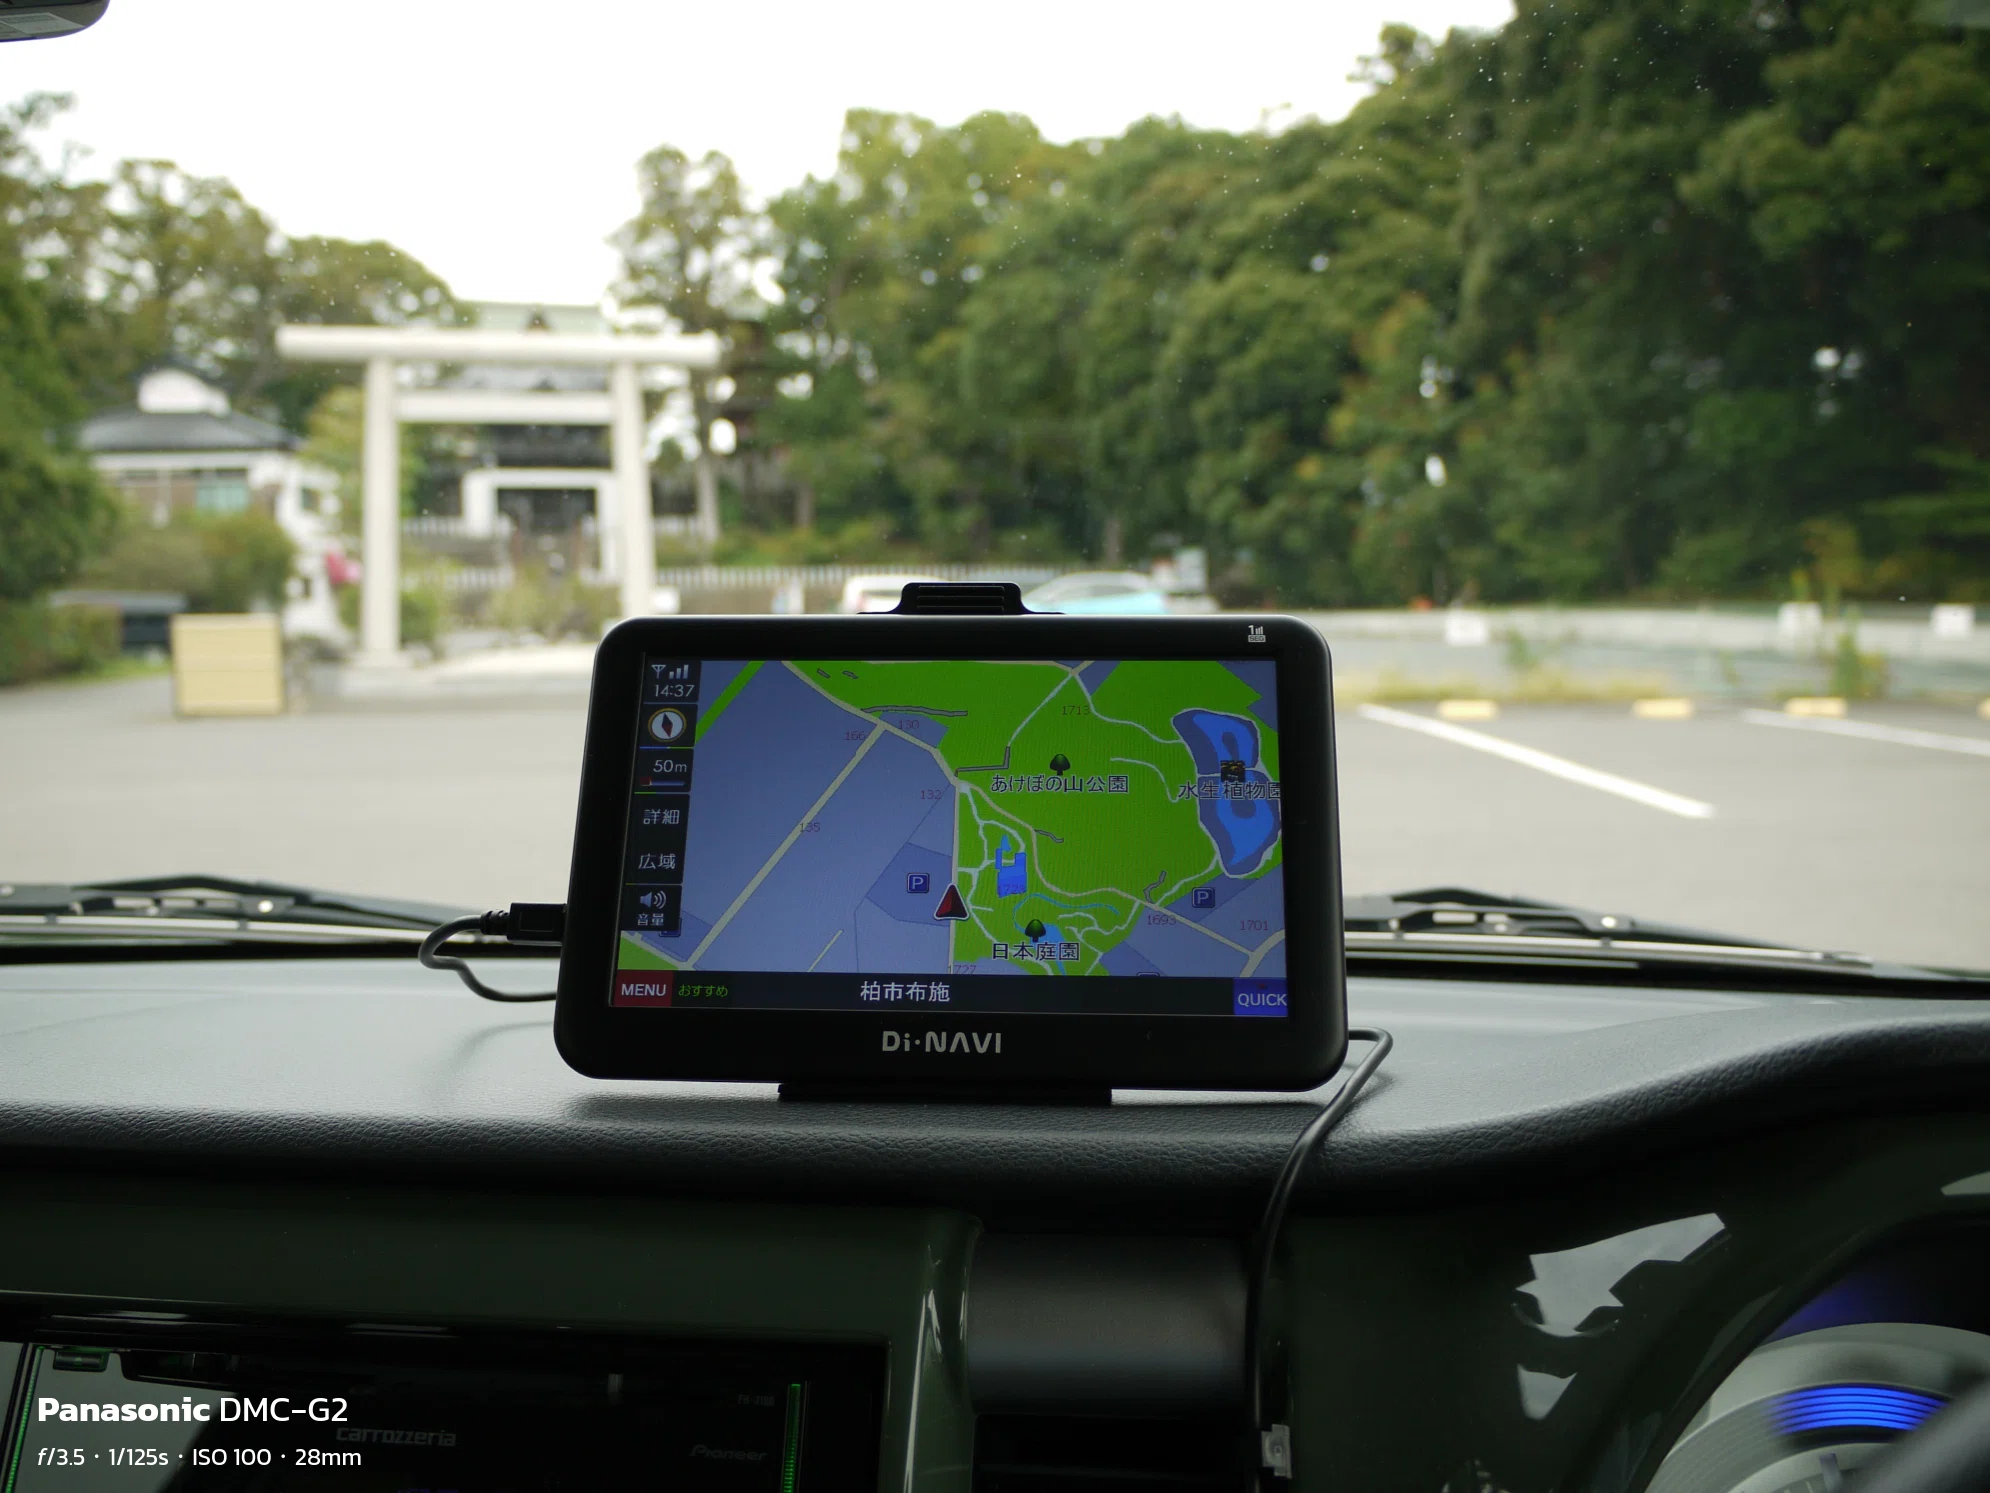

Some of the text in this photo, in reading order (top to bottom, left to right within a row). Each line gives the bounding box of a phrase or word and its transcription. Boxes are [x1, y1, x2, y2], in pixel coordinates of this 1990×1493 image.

[654, 684, 695, 697] 14:37
[898, 720, 919, 730] 130
[653, 759, 687, 773] 50m
[991, 774, 1129, 793] あけぼの山公園
[1178, 780, 1281, 800] 水生植物園
[920, 789, 942, 800] 132
[643, 809, 680, 825] 詳細
[799, 822, 821, 833] 135
[638, 853, 676, 869] 広域
[637, 913, 665, 926] 音量
[1147, 914, 1177, 926] 1693
[1239, 920, 1269, 931] 1701
[992, 942, 1080, 961] 日本庭園
[621, 983, 667, 996] MENU
[678, 984, 729, 997] おすすめ
[860, 981, 950, 1002] 柏市布施
[1237, 993, 1287, 1007] QUICK
[336, 1426, 457, 1447] carrozzeria
[688, 1443, 768, 1461] Pioneer
